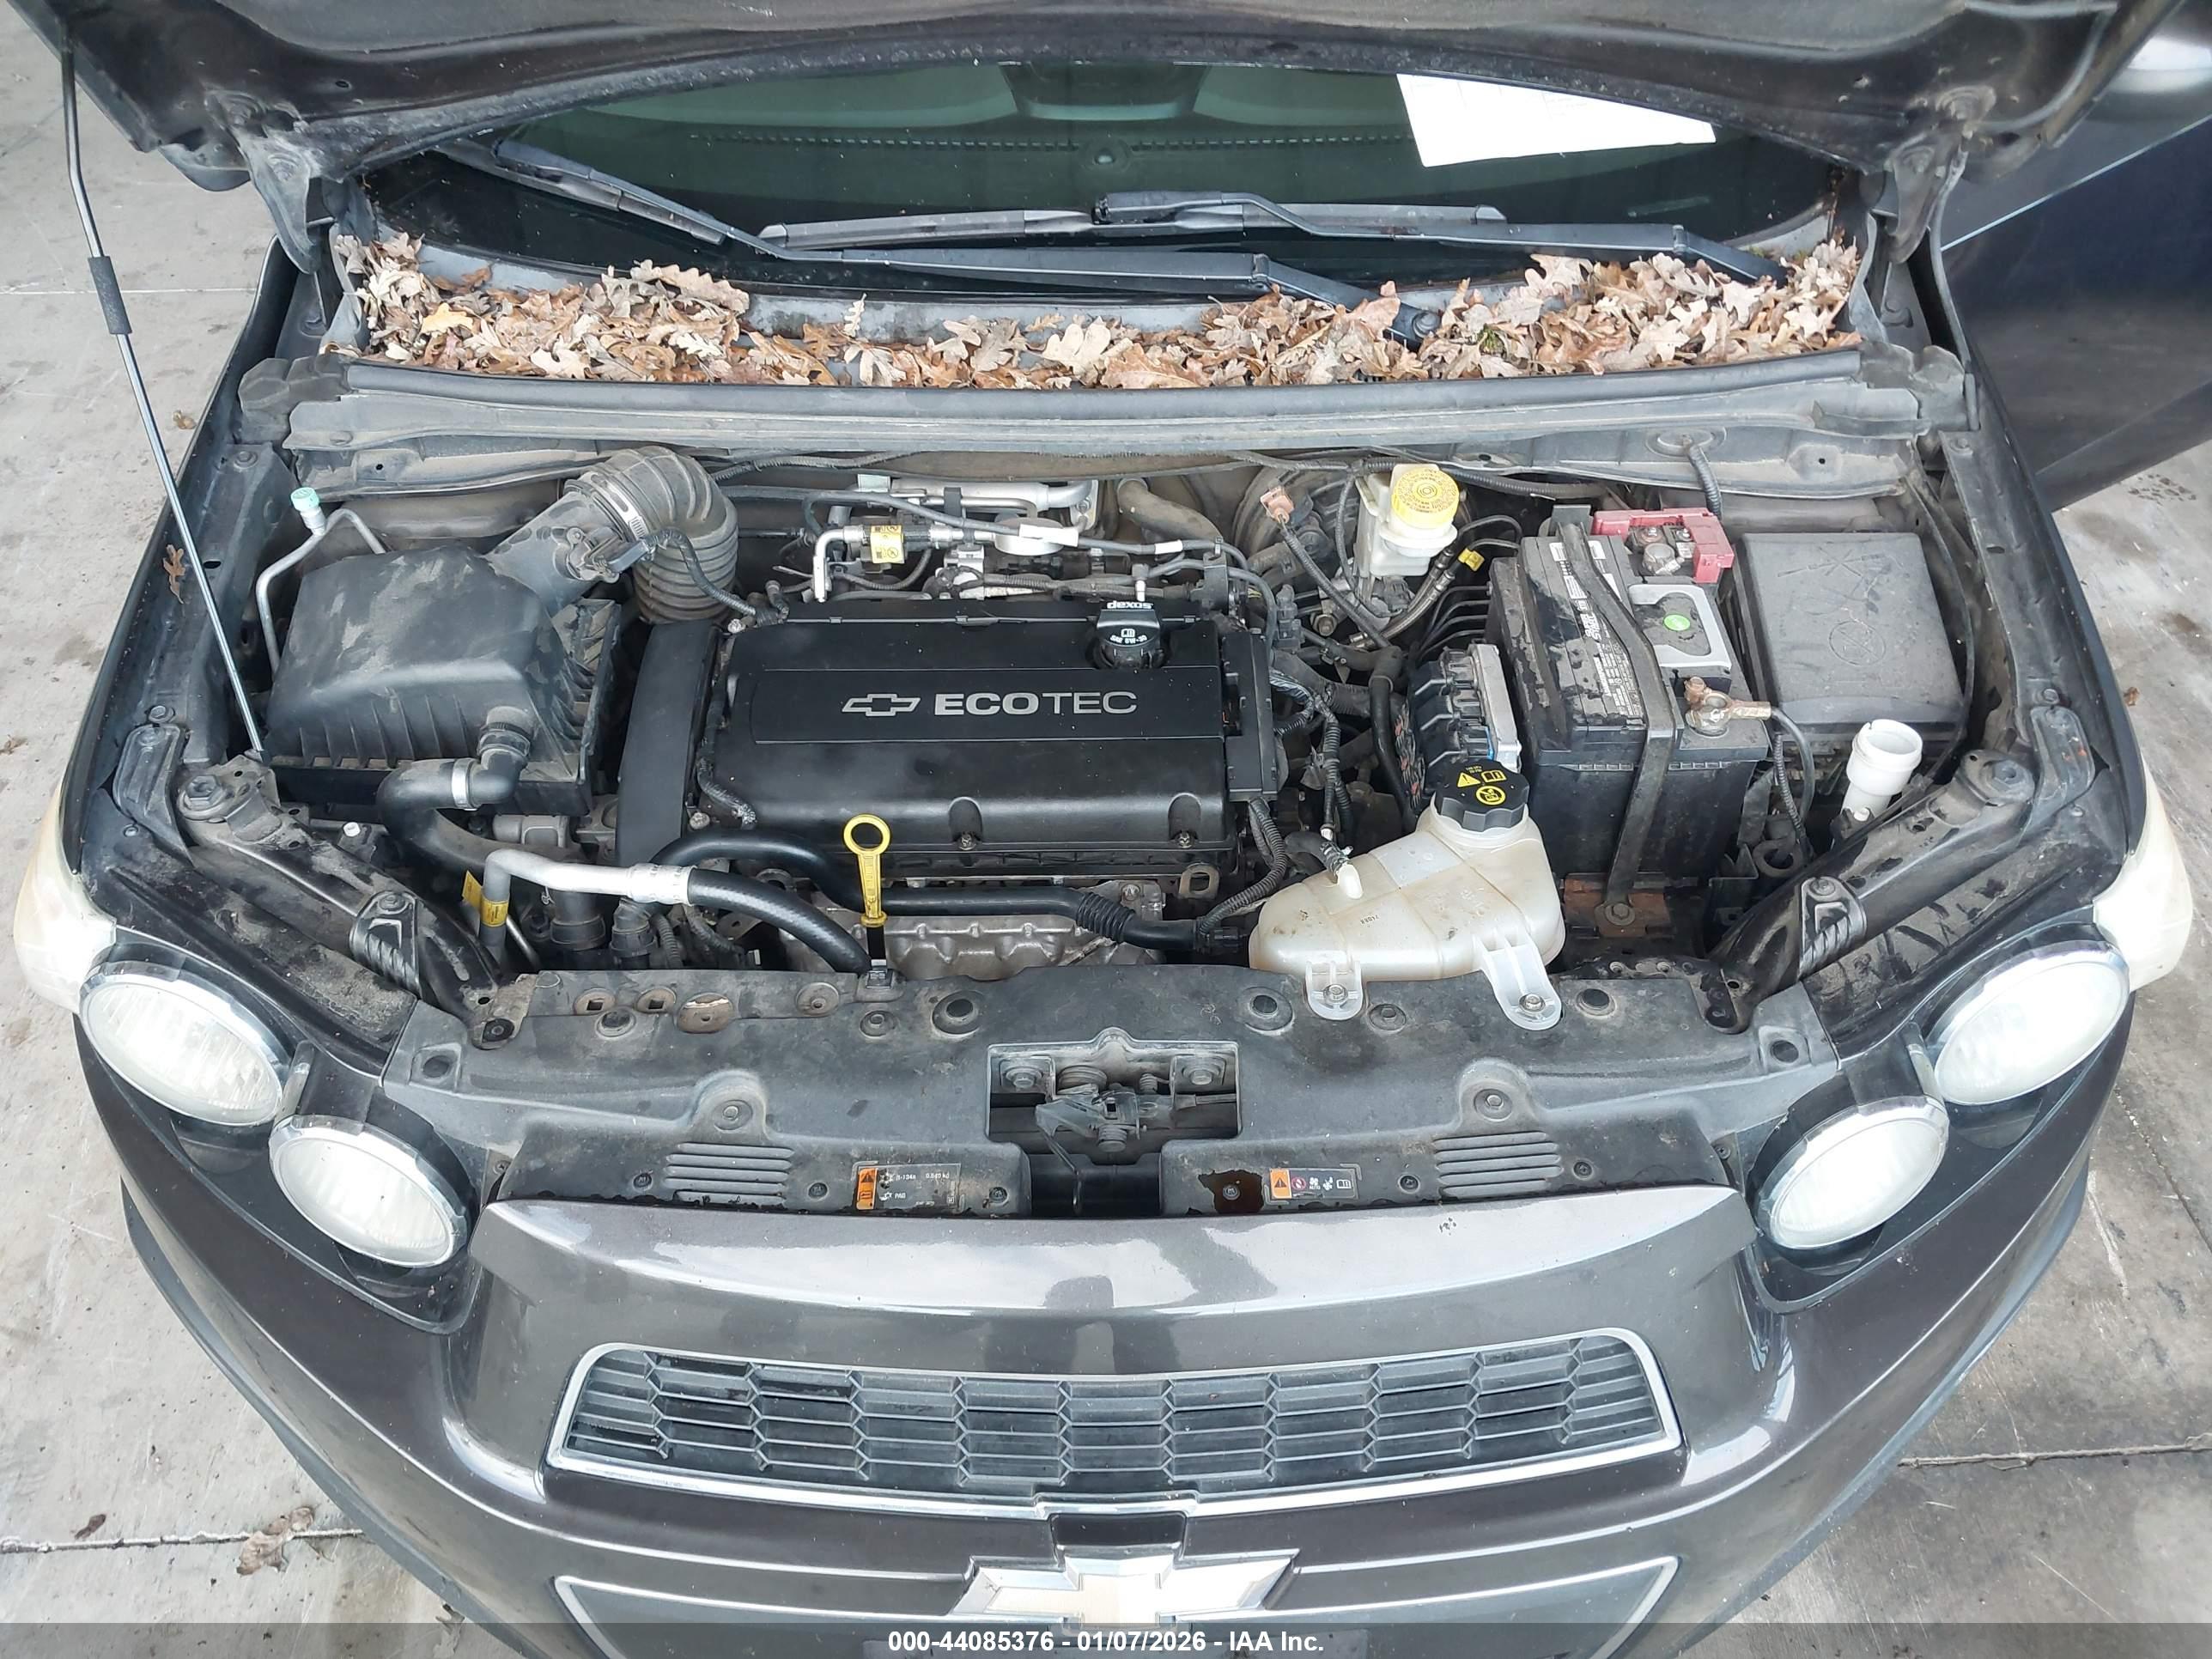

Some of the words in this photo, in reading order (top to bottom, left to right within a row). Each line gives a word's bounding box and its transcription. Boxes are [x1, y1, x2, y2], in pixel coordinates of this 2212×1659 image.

[1107, 600, 1154, 609] dexos
[1109, 635, 1123, 643] SAE
[934, 691, 1137, 715] ECOTEC
